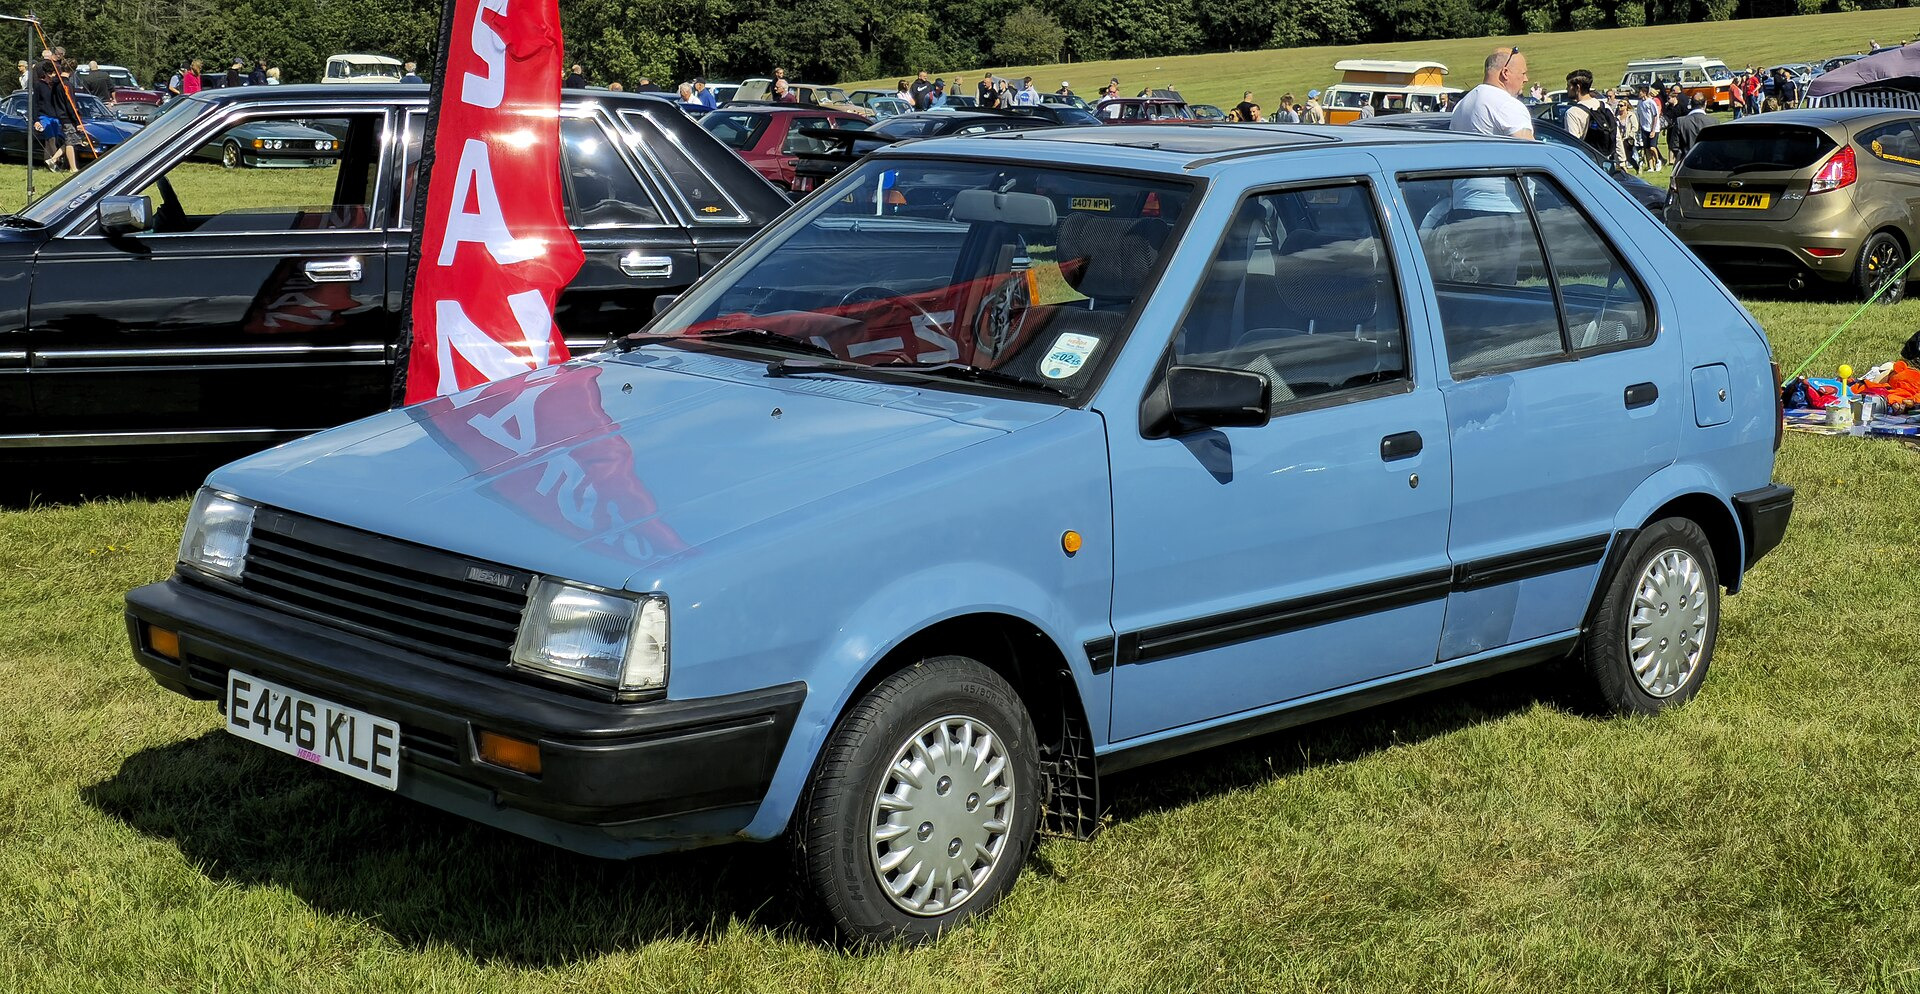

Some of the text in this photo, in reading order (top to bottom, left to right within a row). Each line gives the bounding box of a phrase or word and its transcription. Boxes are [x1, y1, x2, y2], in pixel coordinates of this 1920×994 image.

[1072, 198, 1092, 208] G407
[1710, 193, 1763, 207] EY14 GWN
[231, 678, 393, 779] E446 KLE
